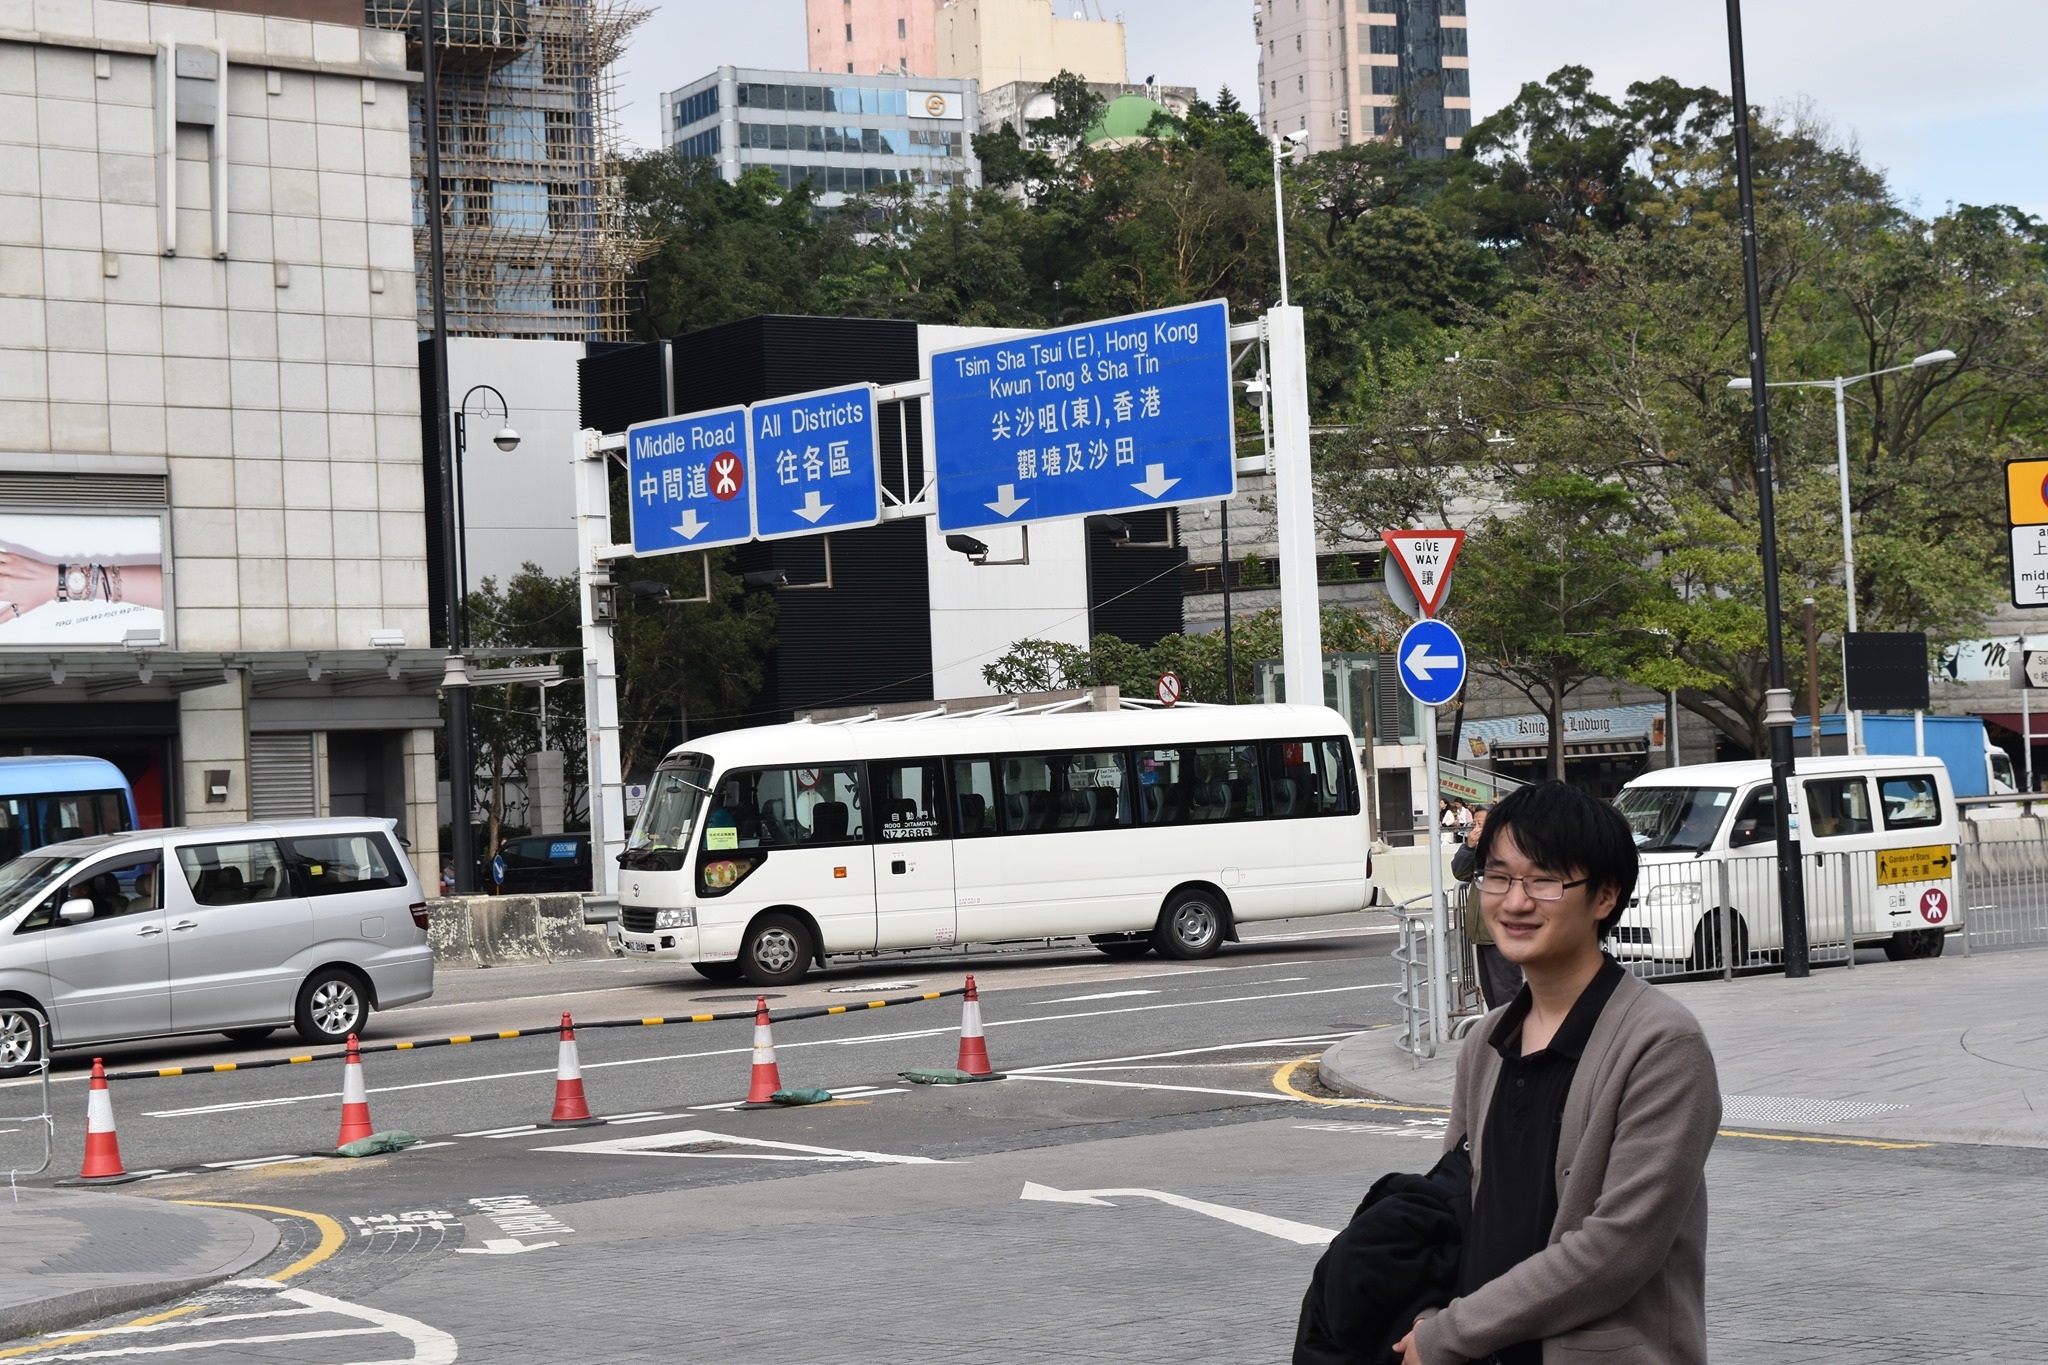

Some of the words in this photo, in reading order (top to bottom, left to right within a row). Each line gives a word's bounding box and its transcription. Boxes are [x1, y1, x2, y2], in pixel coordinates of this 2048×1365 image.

[955, 357, 990, 378] Tsim
[996, 350, 1026, 371] Sha
[1030, 341, 1062, 366] Tsui
[1105, 330, 1148, 353] Hong
[1154, 322, 1198, 345] Kong
[990, 376, 1032, 399] Kwun
[1036, 370, 1075, 392] Tong
[1080, 363, 1092, 384] &
[1098, 360, 1128, 382] Sha
[1133, 353, 1159, 375] Tin
[760, 414, 782, 440] All
[792, 402, 864, 434] Districts
[636, 431, 686, 460] Middle
[692, 421, 736, 450] Road
[1017, 436, 1135, 481] 觀塘及沙田
[775, 440, 852, 486] 往各區
[639, 462, 709, 507] 中間道
[1414, 541, 1439, 552] GIVE
[1415, 554, 1439, 565] WAY
[1422, 570, 1434, 586] 讓
[1518, 719, 1546, 736] King
[1569, 716, 1610, 733] Ludwig
[900, 828, 930, 838] 2686
[1889, 855, 1909, 863] Garden
